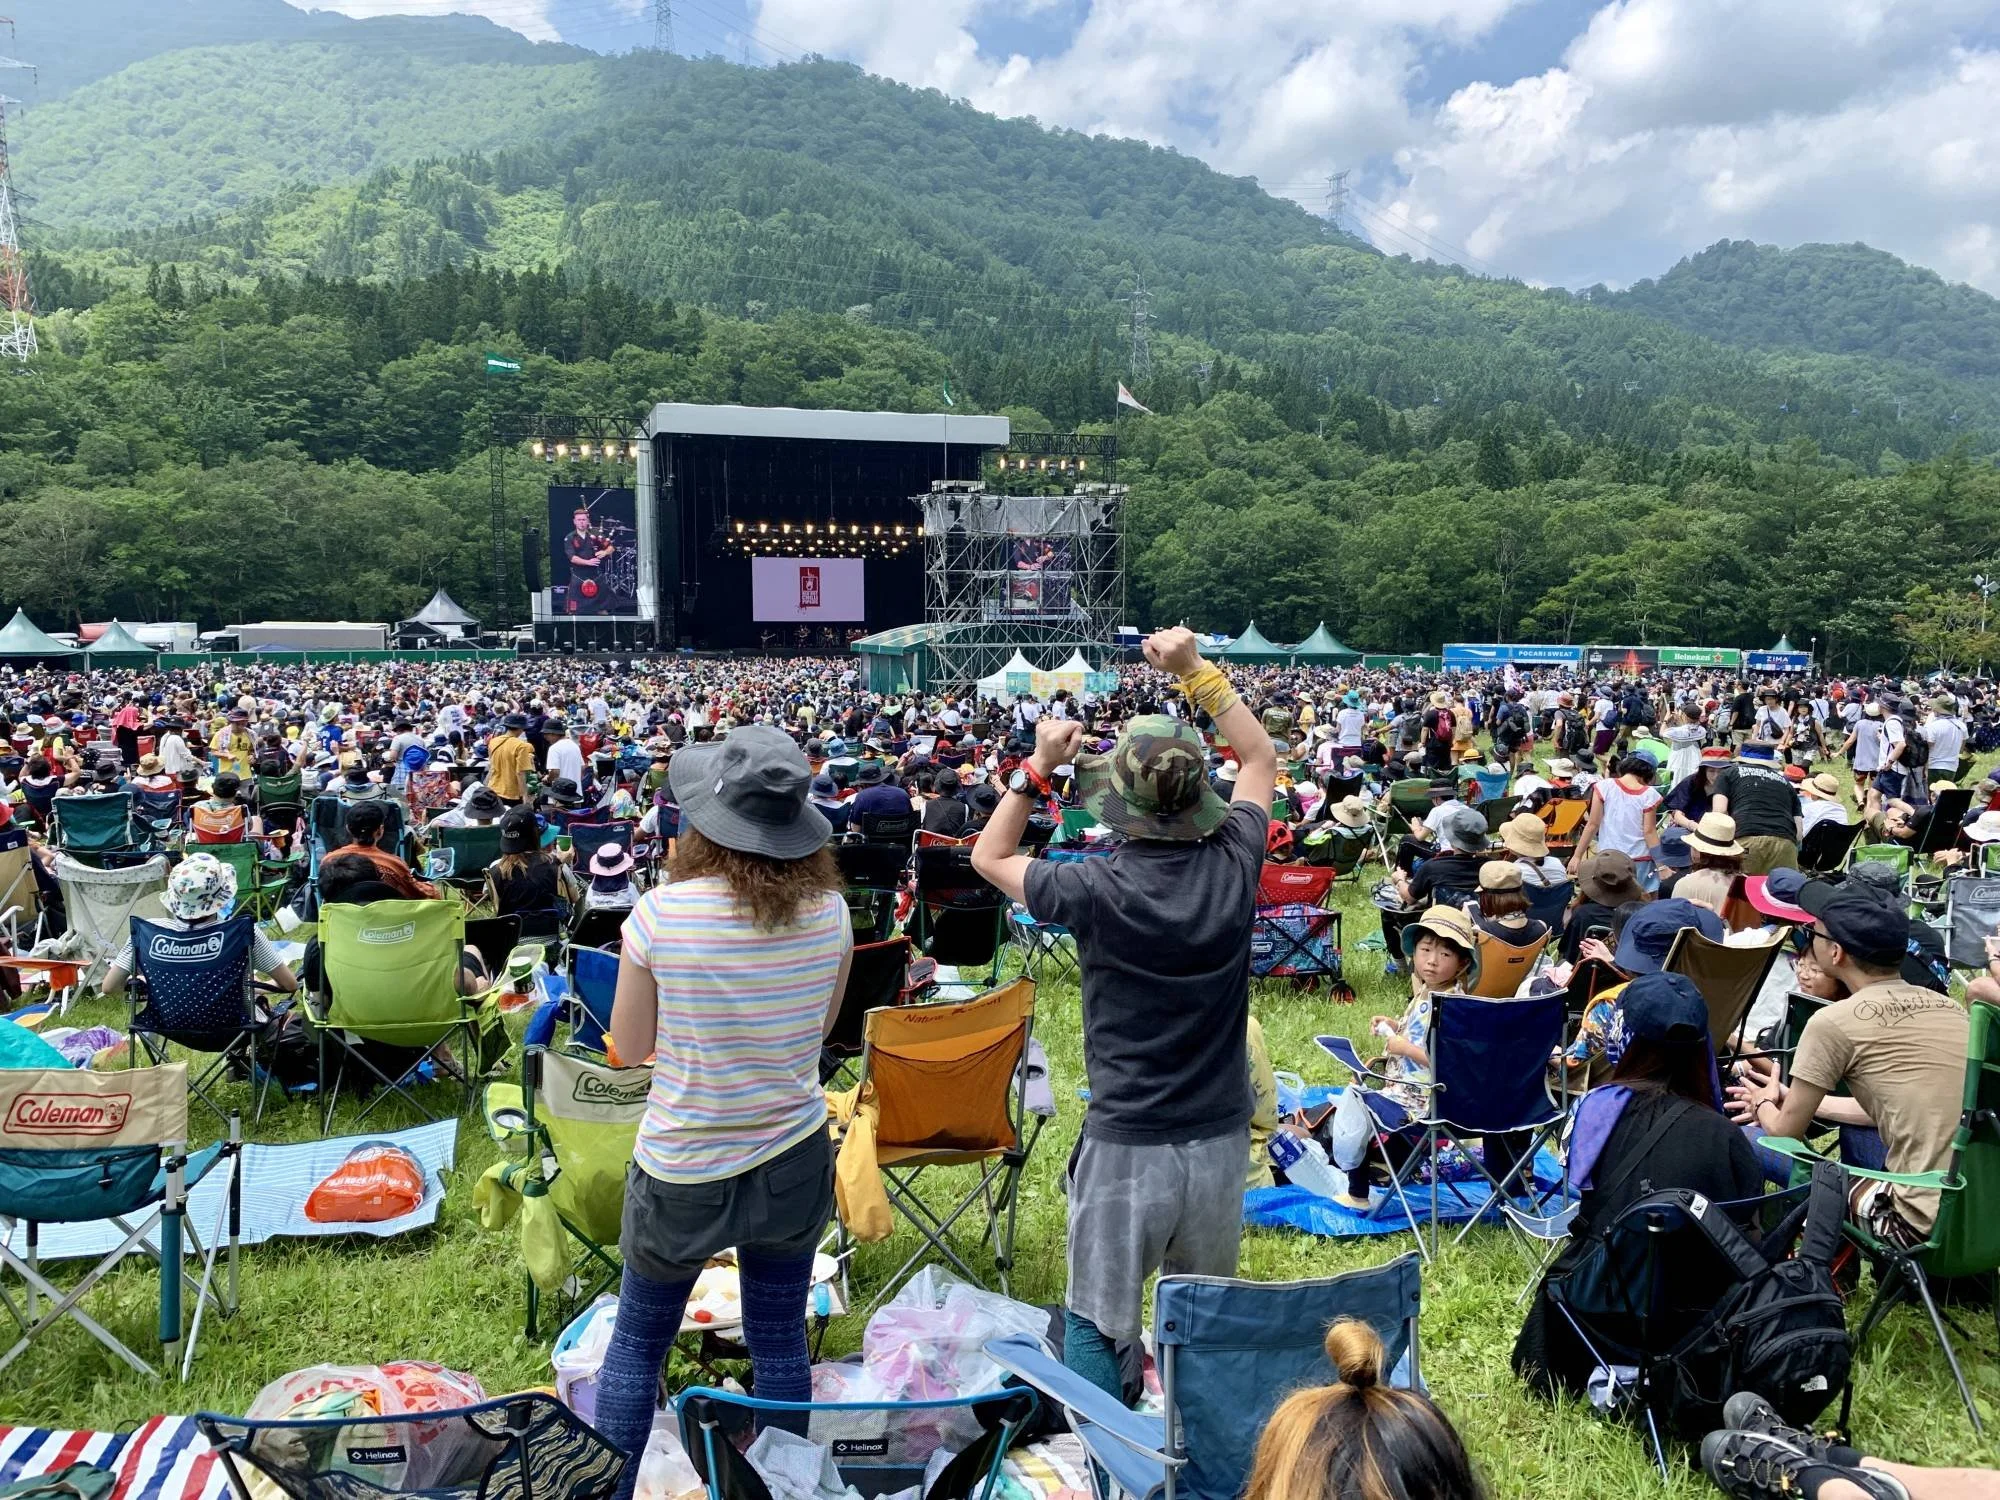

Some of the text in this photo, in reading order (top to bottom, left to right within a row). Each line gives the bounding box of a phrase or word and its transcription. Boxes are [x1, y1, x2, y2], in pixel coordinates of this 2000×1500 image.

[1674, 653, 1710, 661] Heineken
[362, 928, 403, 940] Coleman
[154, 938, 207, 955] Coleman
[16, 1099, 104, 1123] Coleman
[850, 1443, 883, 1451] Helinox
[365, 1450, 400, 1460] Helinox
